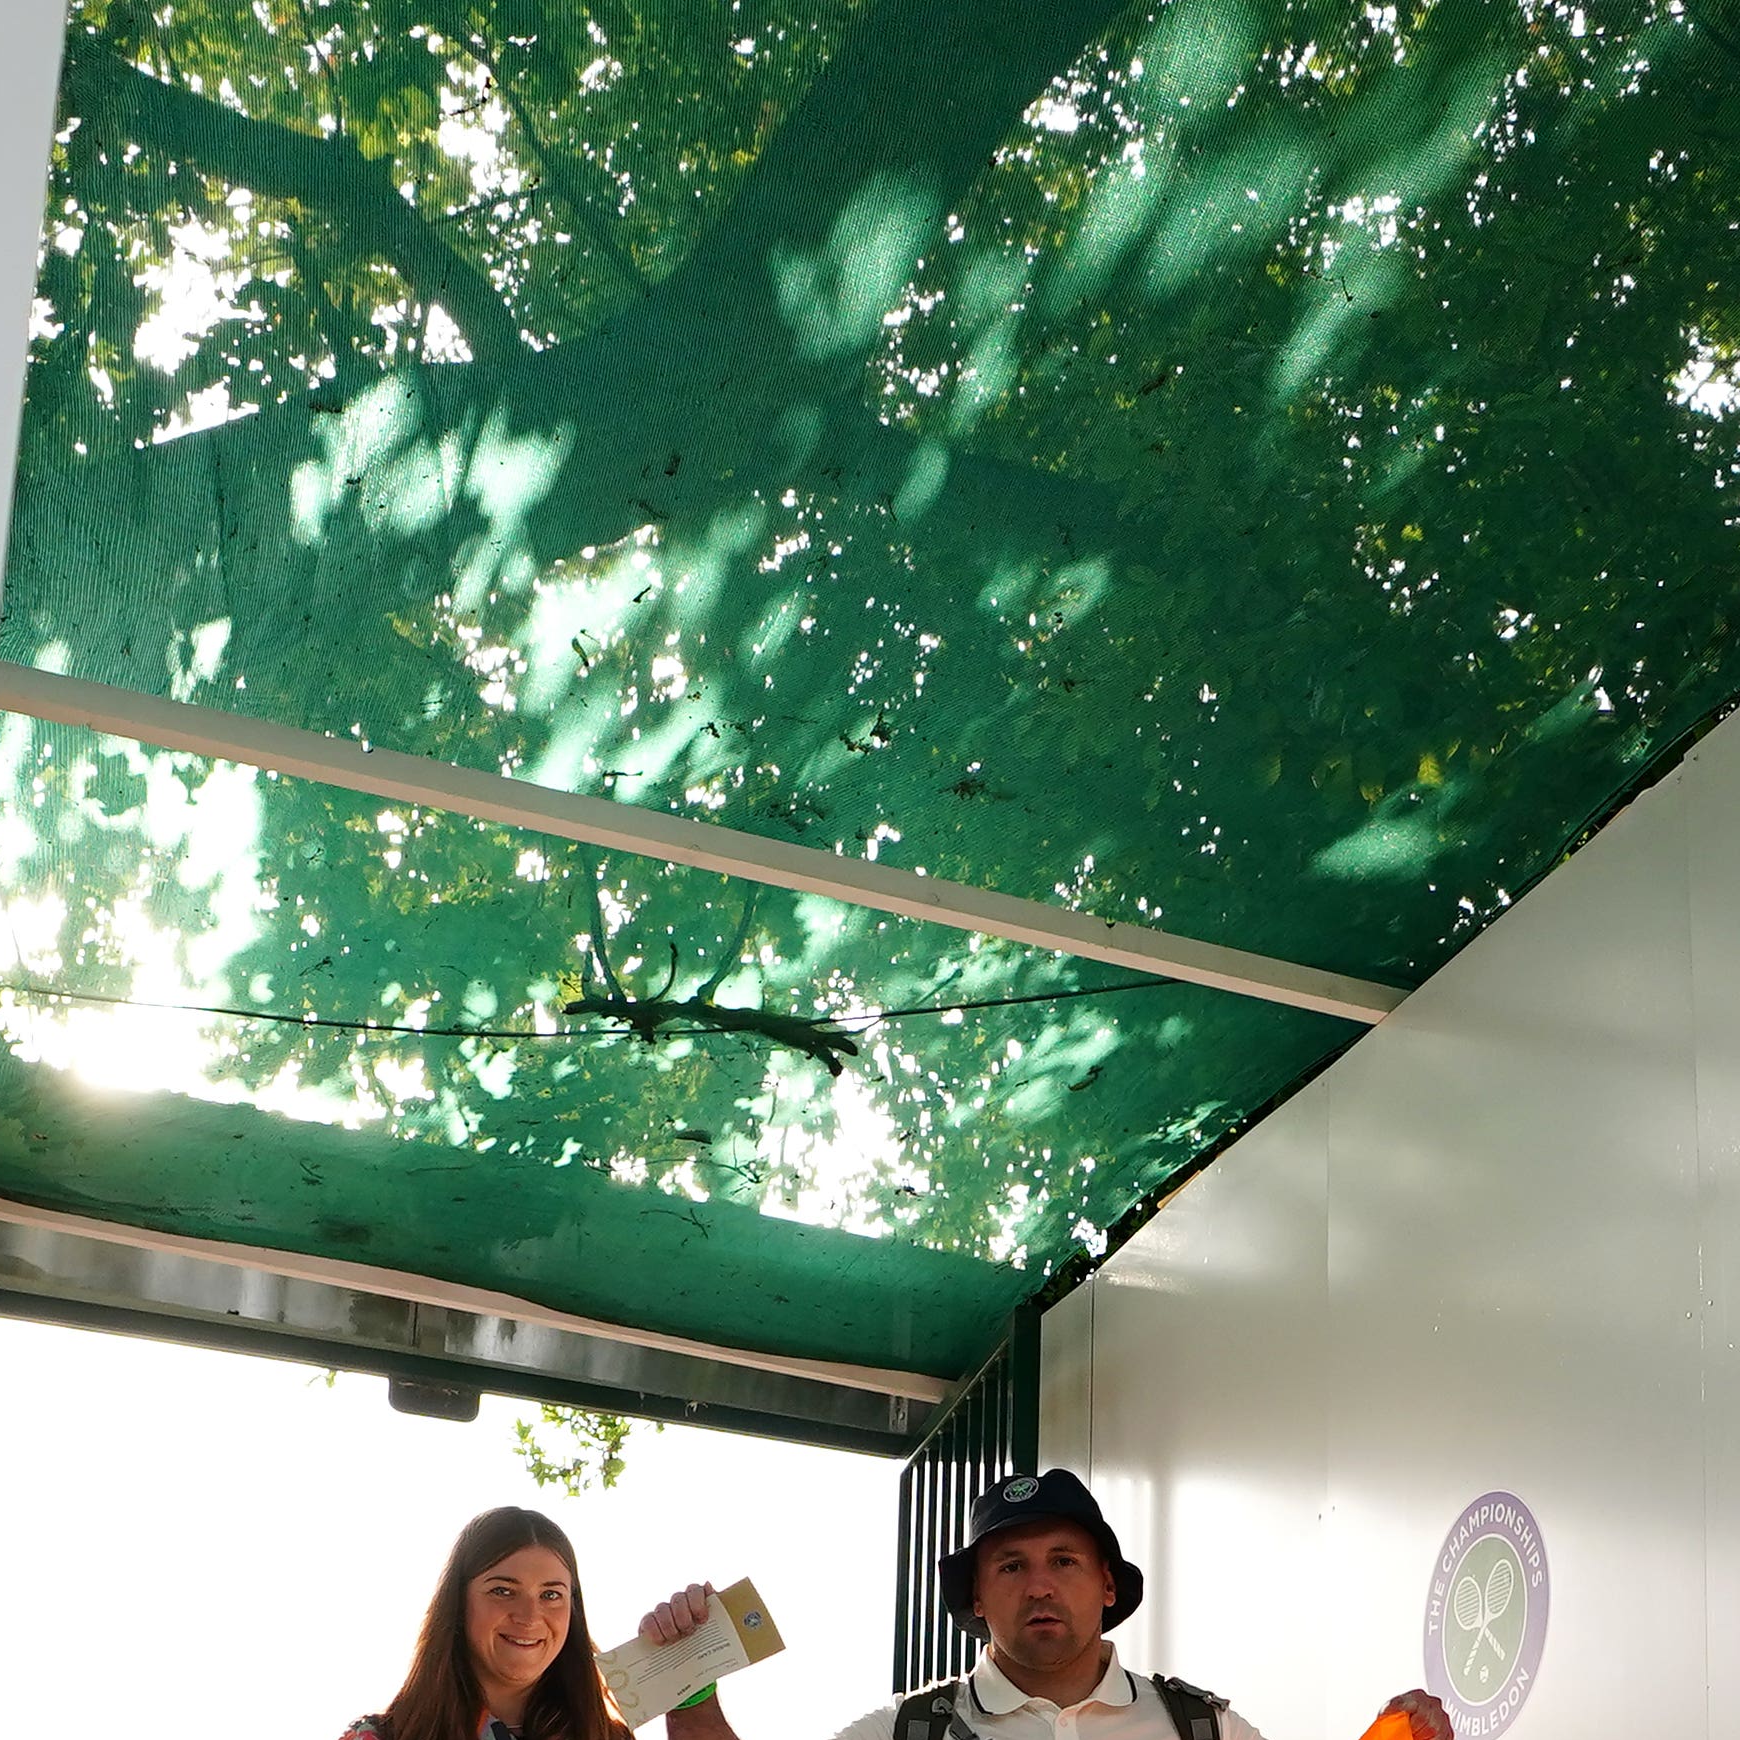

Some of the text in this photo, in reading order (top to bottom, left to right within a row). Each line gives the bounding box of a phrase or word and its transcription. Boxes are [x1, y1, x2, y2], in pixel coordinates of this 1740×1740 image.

[1428, 1503, 1543, 1636] THE CHAMPIONSHIPS
[1445, 1667, 1530, 1737] WIMBLEDON
